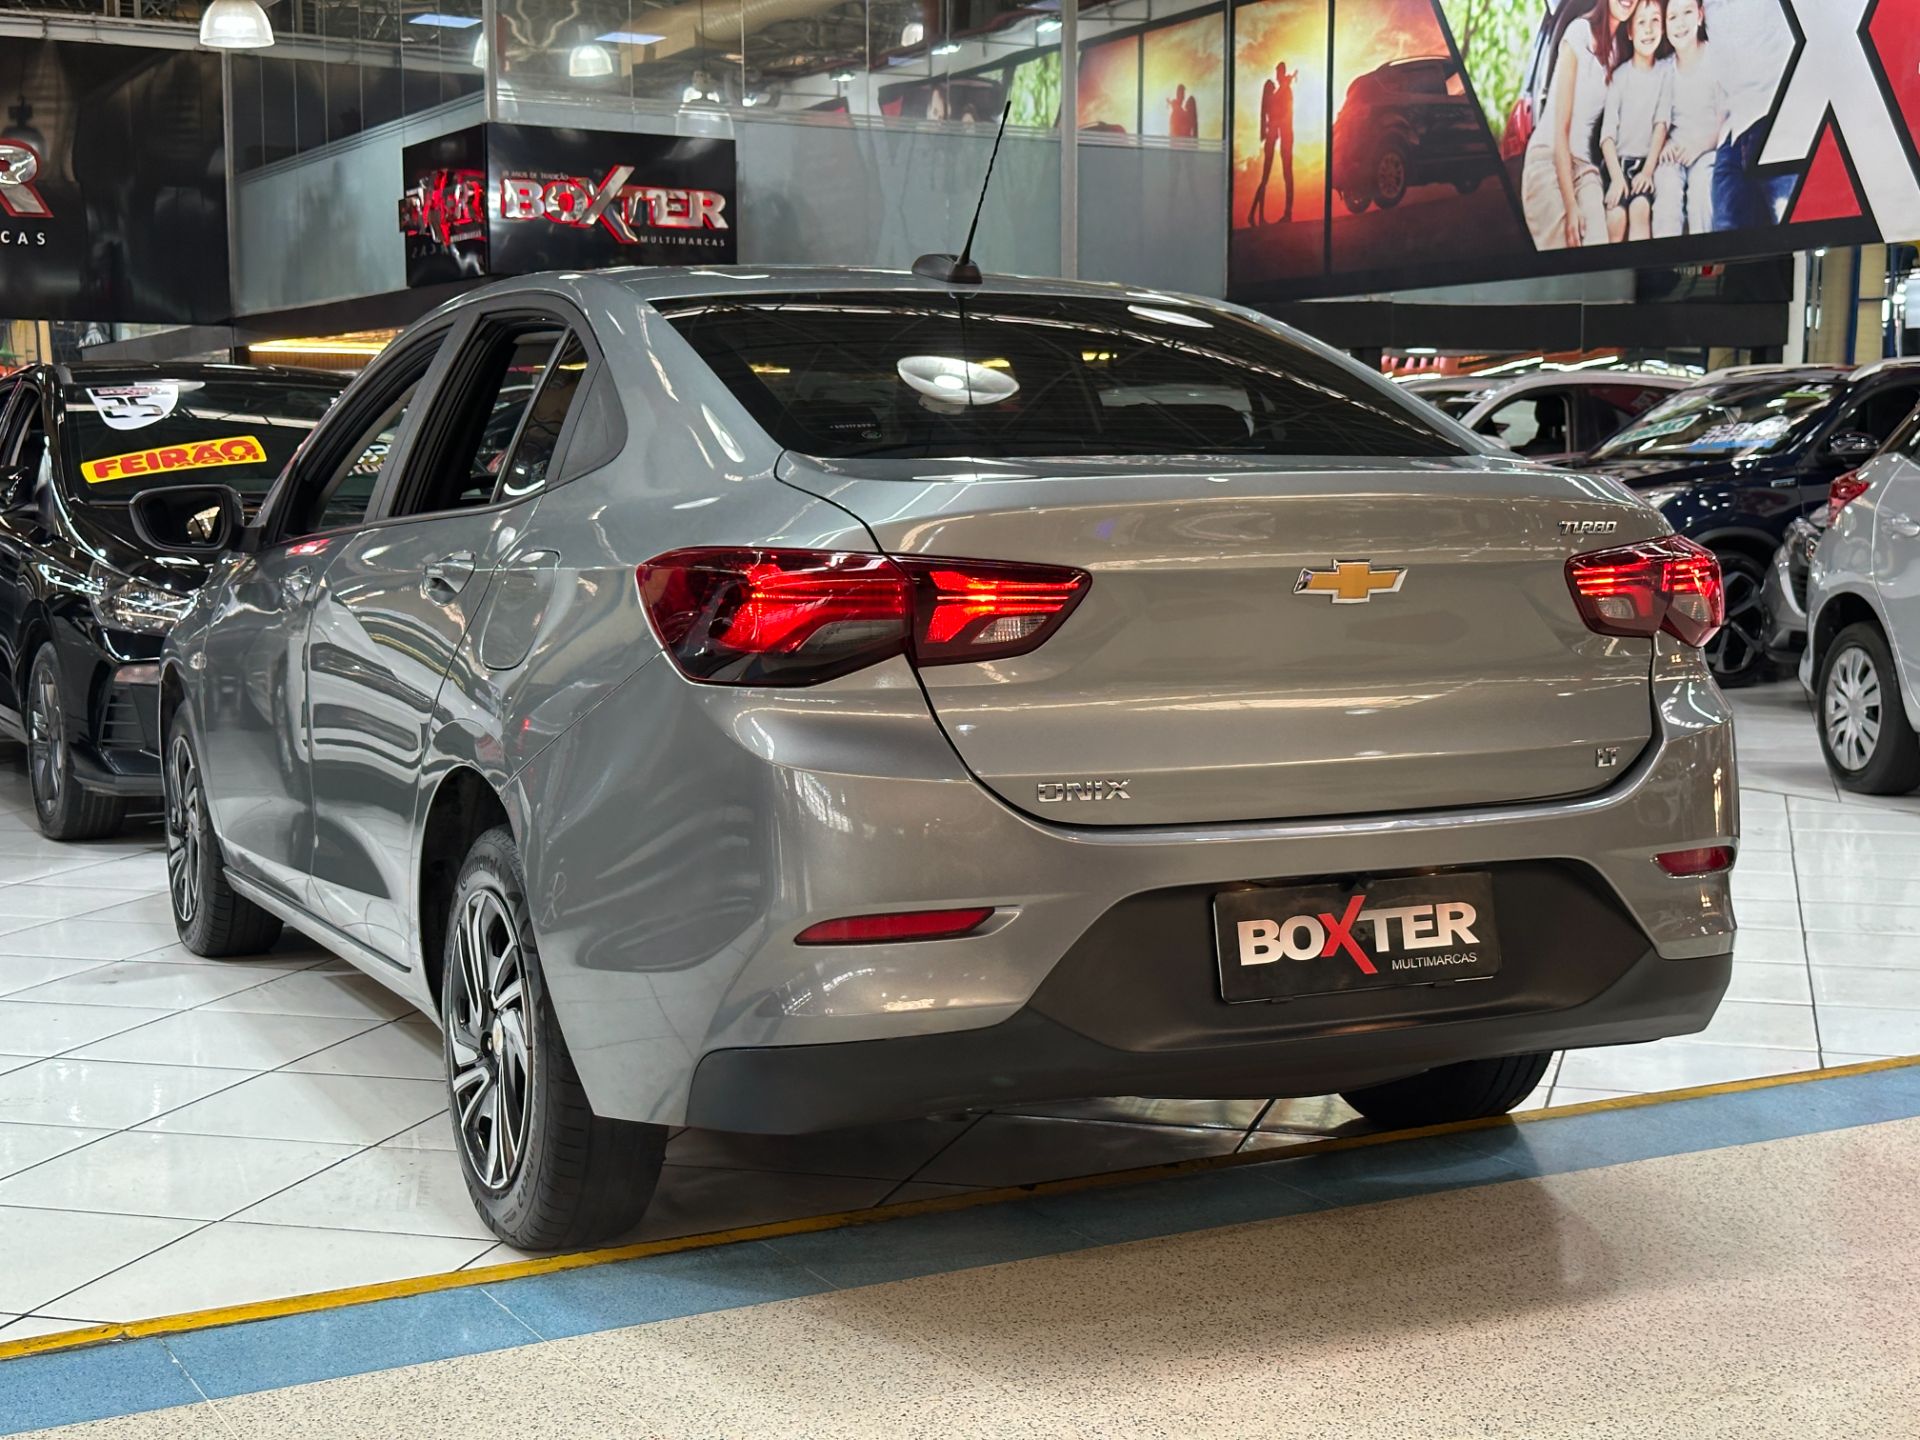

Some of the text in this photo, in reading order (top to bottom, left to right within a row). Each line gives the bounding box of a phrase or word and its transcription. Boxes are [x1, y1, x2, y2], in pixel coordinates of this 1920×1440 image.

[500, 165, 729, 244] BOXTER
[639, 235, 726, 248] MULTIMARCAS
[93, 438, 257, 479] FEIRÃO
[1558, 520, 1617, 536] TURBO
[1596, 746, 1621, 768] LT
[1037, 779, 1131, 802] ONIX
[1237, 895, 1480, 975] BOXTER
[1391, 952, 1477, 970] MULTIMARCAS
